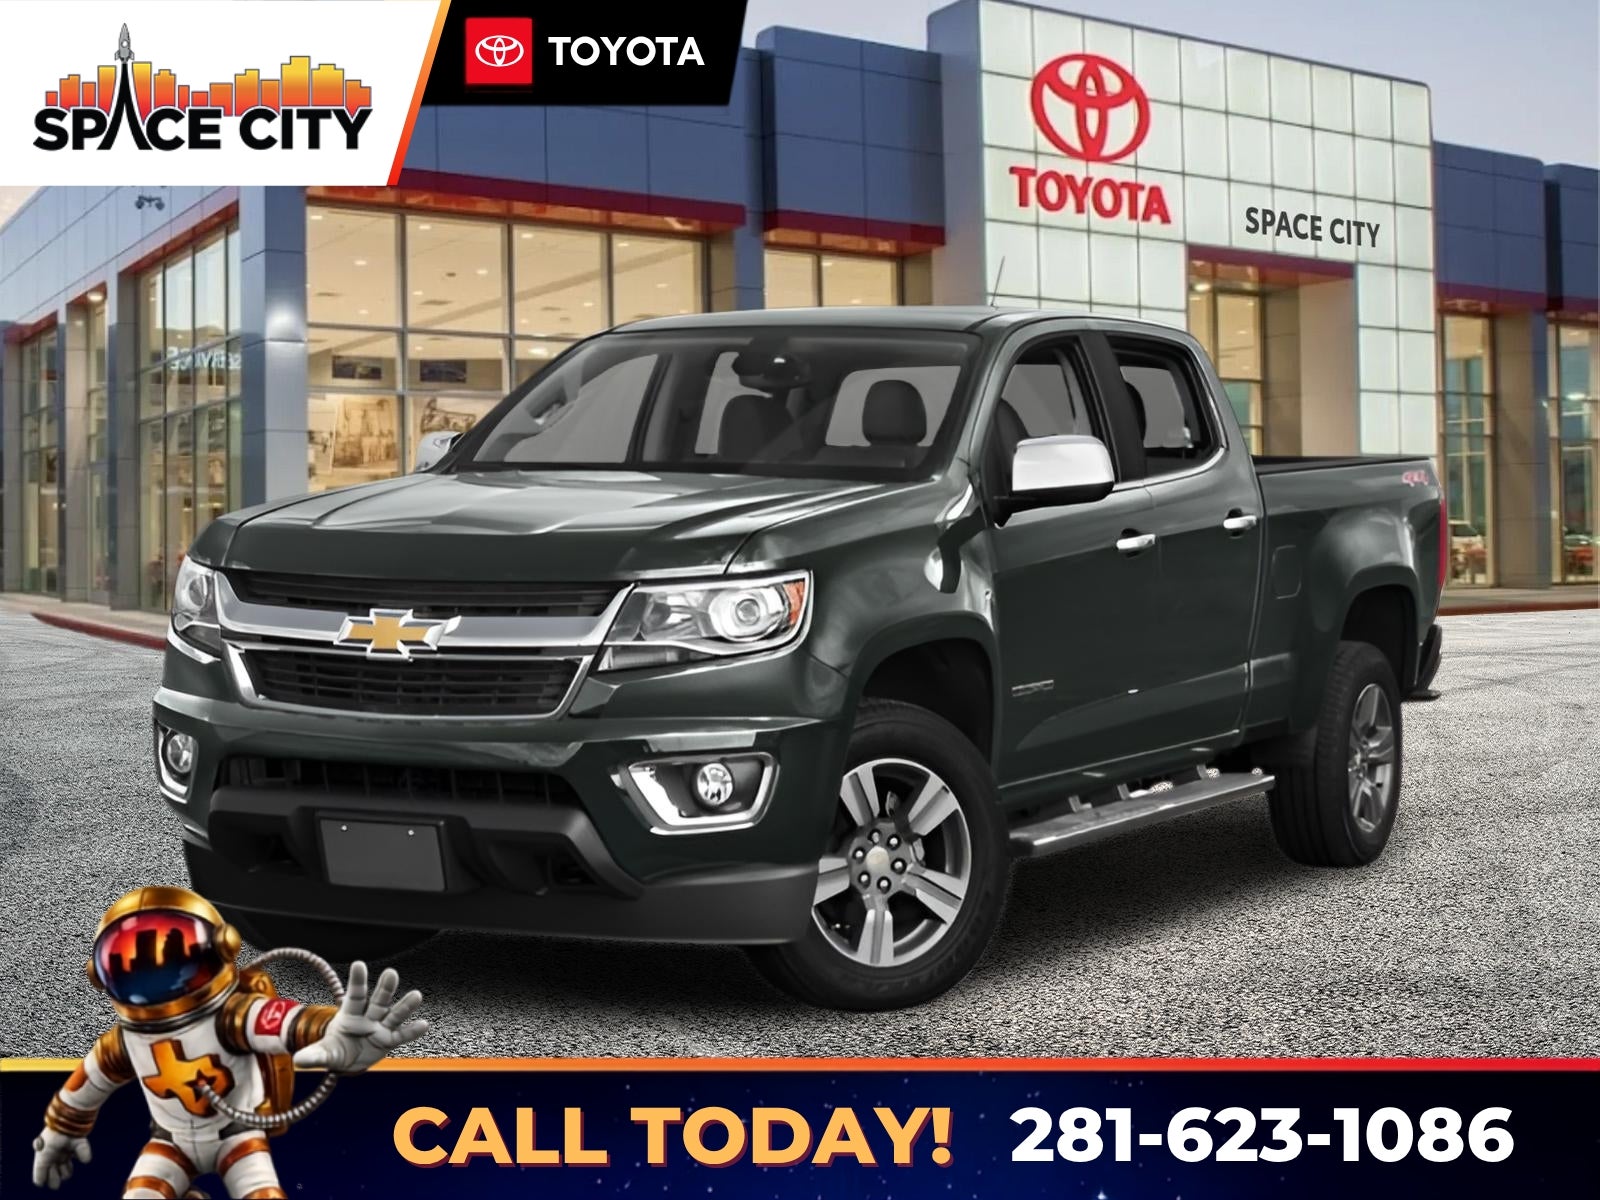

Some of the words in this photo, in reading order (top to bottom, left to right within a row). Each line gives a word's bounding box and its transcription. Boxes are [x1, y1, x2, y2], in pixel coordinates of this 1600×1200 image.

[1009, 166, 1171, 224] TOYOTA
[1245, 206, 1323, 241] SPACE
[1329, 218, 1380, 248] CITY
